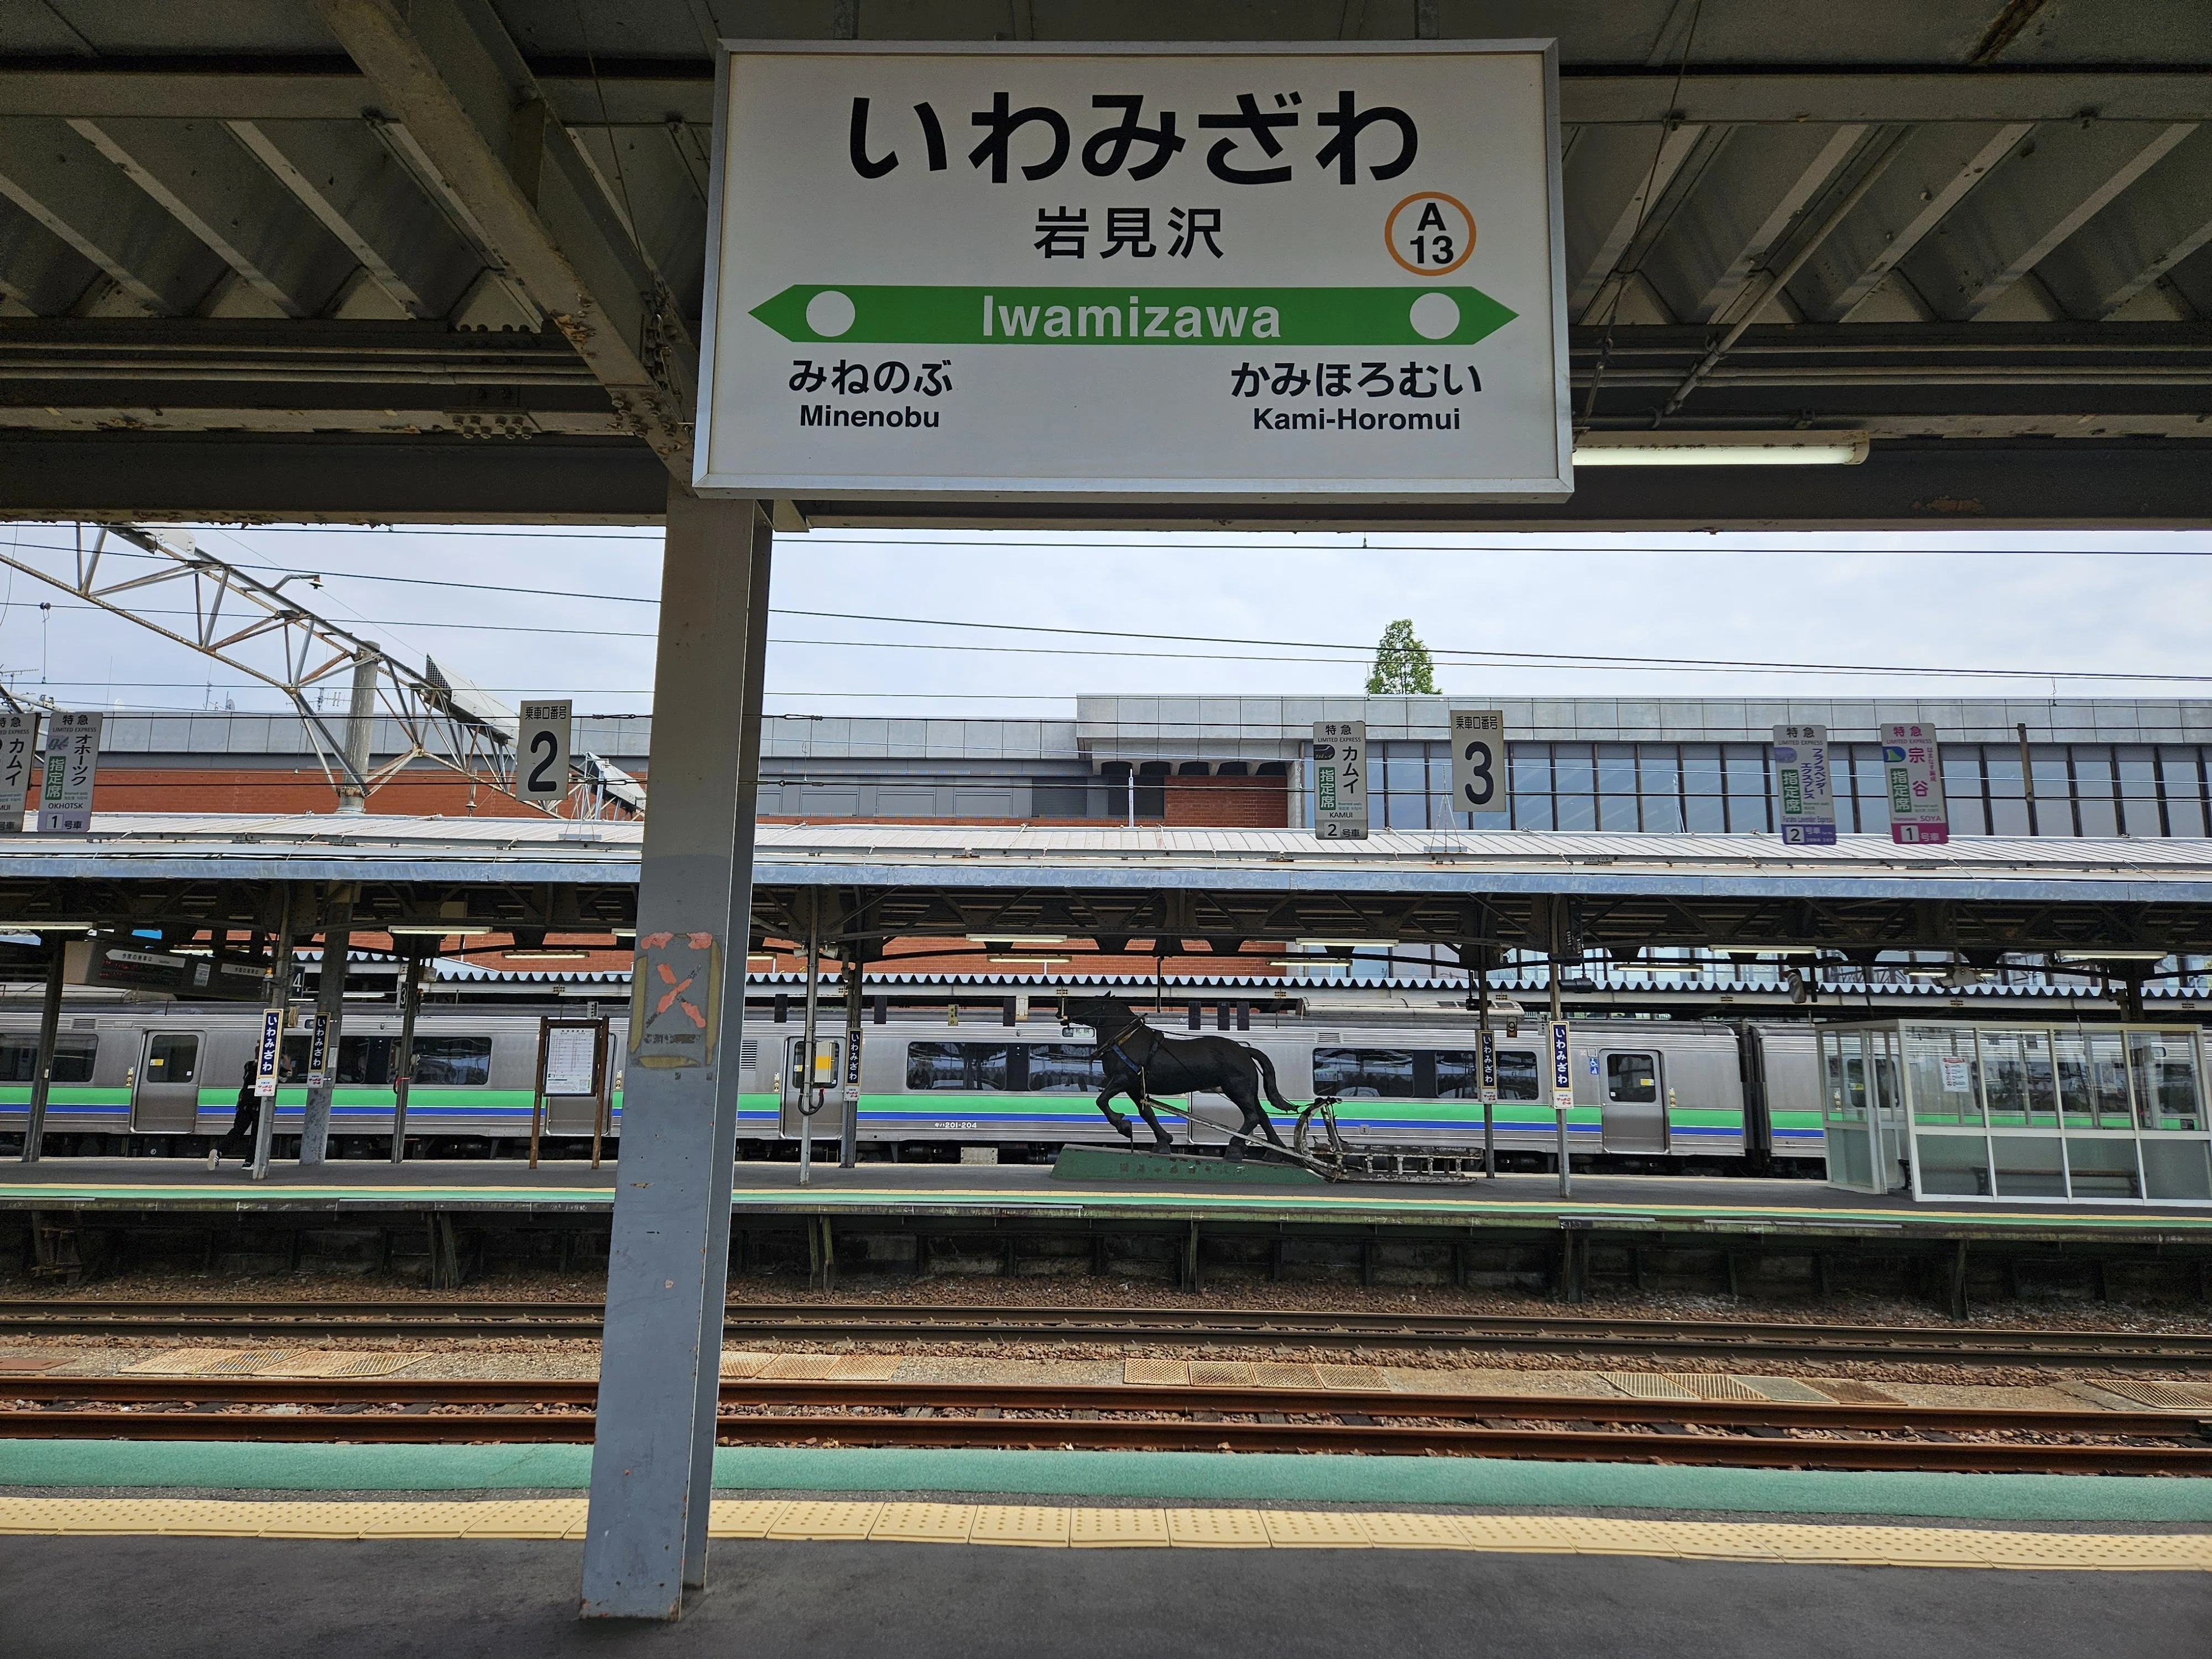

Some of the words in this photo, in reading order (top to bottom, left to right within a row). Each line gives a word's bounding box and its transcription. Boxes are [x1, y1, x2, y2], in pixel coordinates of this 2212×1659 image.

[849, 90, 1418, 186] いわみざわ
[1034, 205, 1224, 260] 岩見沢
[1416, 202, 1447, 231] A
[1409, 234, 1454, 265] 13
[983, 295, 1282, 338] Iwamizawa
[788, 358, 953, 398] みねのぶ
[1230, 361, 1483, 399] かみほろむい
[800, 404, 940, 429] Minenobu
[1253, 407, 1460, 431] Kami-Horomui
[62, 715, 88, 725] 特急
[525, 706, 566, 719] 乗車口番号
[1325, 724, 1352, 735] 特急
[1456, 716, 1498, 729] 乗車口番号
[1893, 726, 1922, 737] 特急
[1786, 727, 1814, 738] 特急
[6, 738, 24, 786] カムイ
[46, 759, 65, 798] 指定席
[71, 734, 92, 786] オホーツク
[528, 731, 557, 792] 2
[1342, 746, 1359, 794] カムイ
[1465, 741, 1494, 805] 3
[1812, 748, 1827, 795] フラノラベンダー
[1908, 747, 1929, 797] 宗谷
[1320, 769, 1334, 808] 指定席
[1783, 772, 1800, 812] 指定席
[1892, 771, 1910, 811] 指定席
[51, 816, 58, 828] 1
[64, 821, 82, 829] 号車
[1328, 823, 1337, 836] 2
[1342, 829, 1360, 837] 号車
[1791, 828, 1801, 841] 2
[1906, 827, 1913, 841] 1
[1921, 832, 1940, 842] 号車
[292, 973, 301, 992] 4
[400, 988, 406, 1005] 3
[262, 1016, 278, 1072] いわみざわ
[312, 1019, 325, 1067] いわみざわ
[1509, 1021, 1515, 1032] 9
[849, 1034, 859, 1081] いわみざわ
[1483, 1036, 1493, 1083] いわみざわ
[1555, 1028, 1568, 1084] いわみざわ
